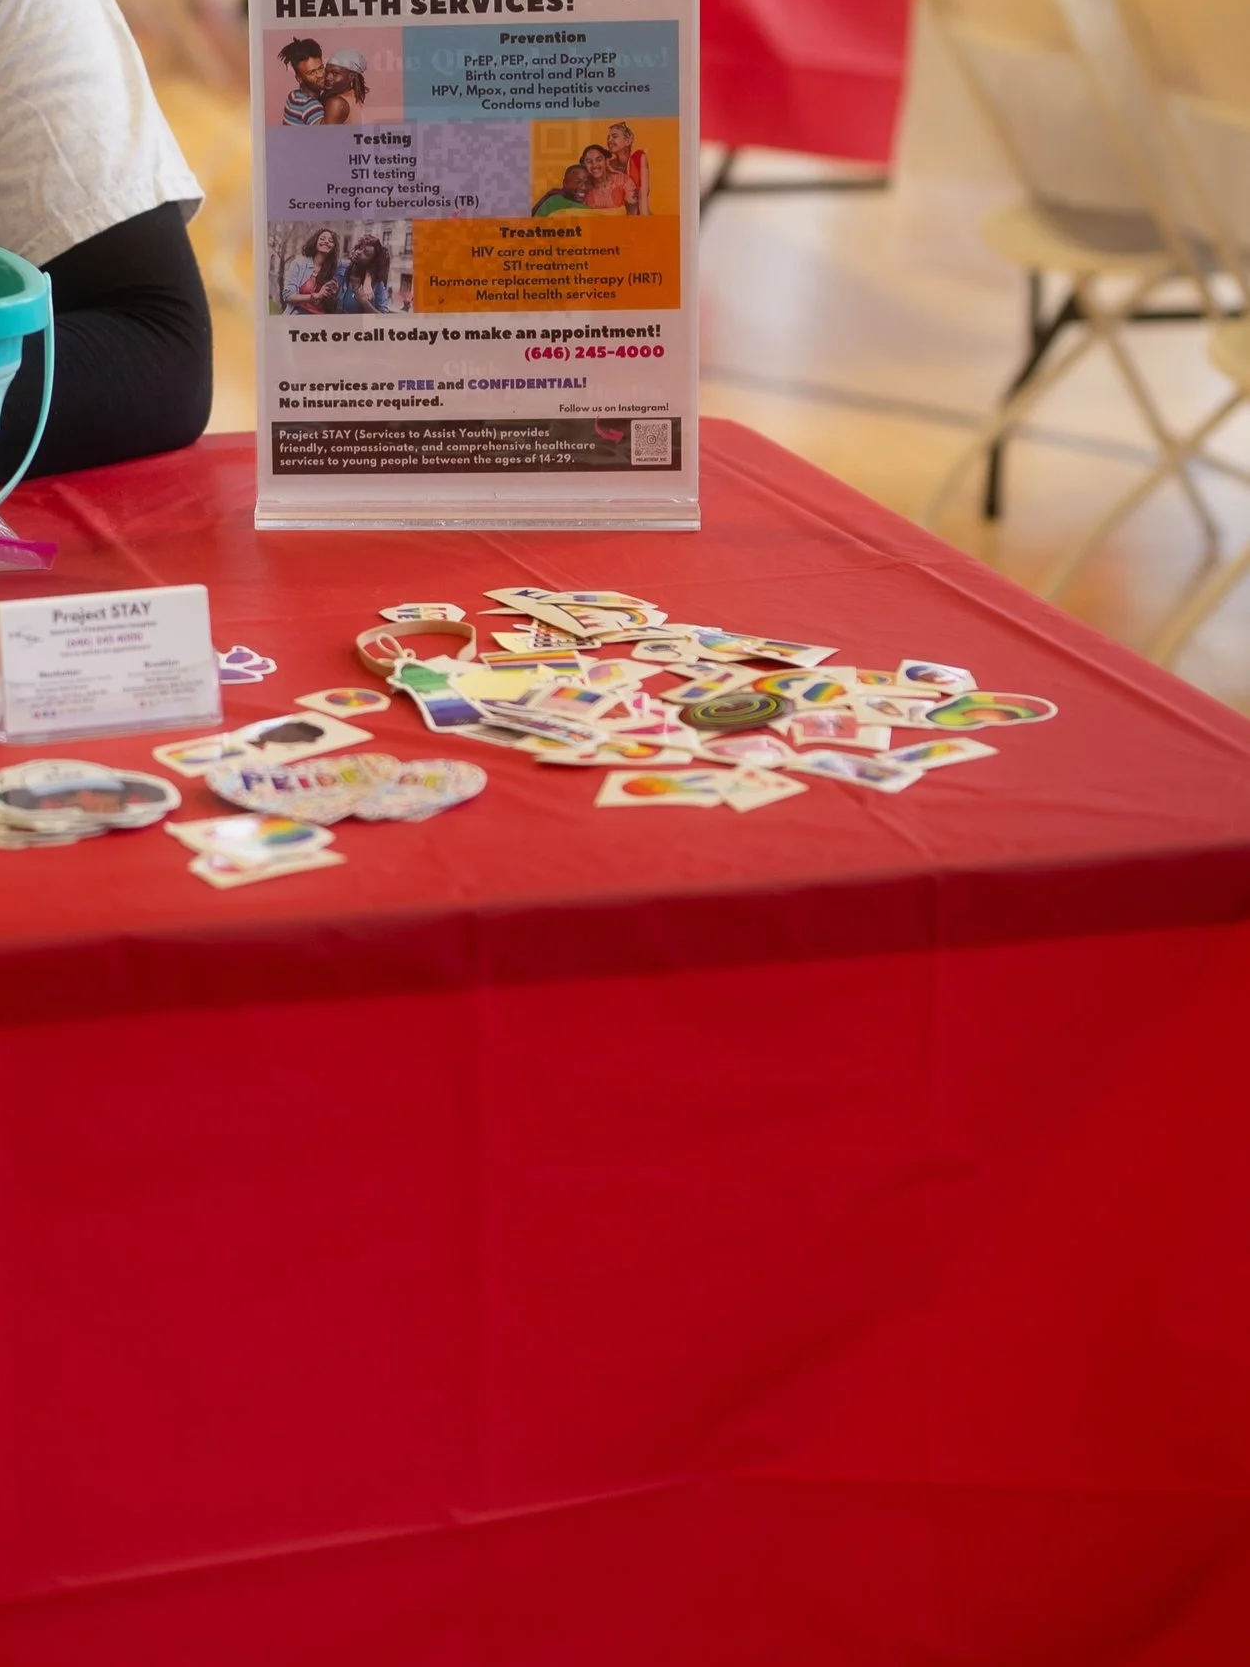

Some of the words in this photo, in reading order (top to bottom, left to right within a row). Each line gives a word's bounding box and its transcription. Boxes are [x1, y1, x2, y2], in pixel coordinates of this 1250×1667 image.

[500, 30, 585, 43] Prevention
[464, 55, 496, 66] PrEP,
[499, 54, 527, 65] PEP,
[532, 54, 556, 64] and
[560, 52, 616, 66] DoxyPEP
[465, 69, 495, 80] Birth
[499, 68, 543, 79] control
[547, 68, 571, 78] and
[576, 68, 603, 78] Plan
[608, 67, 615, 77] B
[432, 85, 463, 96] HPV,
[466, 84, 505, 97] Mpox,
[509, 83, 533, 94] and
[538, 82, 592, 98] hepatitis
[596, 81, 649, 92] vaccines
[481, 98, 540, 109] Condoms
[544, 95, 568, 108] and
[573, 96, 599, 107] lube
[354, 132, 411, 147] Testing
[349, 154, 370, 164] HIV
[374, 153, 416, 167] testing
[351, 168, 368, 178] STI
[373, 165, 415, 181] testing
[327, 183, 393, 196] Pregnancy
[397, 180, 439, 195] testing
[288, 198, 350, 210] Screening
[354, 196, 372, 208] for
[375, 193, 450, 207] tuberculosis
[454, 195, 479, 209] (TB)
[500, 226, 582, 237] Treatment
[471, 246, 493, 256] HIV
[529, 247, 552, 256] and
[556, 246, 619, 255] treatment
[503, 260, 521, 270] STI
[525, 261, 588, 270] treatment
[430, 276, 488, 287] Hormone
[492, 275, 570, 289] replacement
[573, 274, 624, 288] therapy
[627, 273, 662, 285] (HRT)
[475, 289, 519, 300] Mental
[522, 288, 562, 299] health
[565, 288, 616, 298] services
[288, 329, 327, 341] Text
[331, 332, 350, 341] or
[353, 328, 384, 341] call
[388, 327, 438, 345] today
[441, 328, 460, 340] to
[464, 327, 511, 339] make
[515, 329, 536, 338] an
[540, 324, 660, 342] appointment!
[524, 346, 569, 361] (646)
[575, 345, 664, 358] 245-4000
[278, 381, 306, 391] Our
[309, 379, 367, 390] services
[370, 382, 394, 390] are
[398, 380, 434, 390] FREE
[437, 379, 463, 389] and
[467, 377, 586, 389] CONFIDENTIAL!
[279, 398, 299, 407] No
[303, 397, 373, 408] insurance
[376, 395, 443, 409] required.
[559, 404, 589, 412] Follow
[618, 403, 668, 413] Instagram!
[279, 430, 317, 444] Project
[322, 430, 350, 438] STAY
[354, 429, 404, 443] (Services
[423, 428, 455, 442] Assist
[459, 428, 496, 442] Youth)
[500, 428, 549, 442] provides
[279, 443, 327, 455] friendly,
[330, 443, 417, 453] compassionate,
[421, 442, 442, 456] and
[446, 441, 531, 453] comprehensive
[535, 441, 595, 451] healthcare
[280, 457, 324, 466] services
[342, 456, 376, 467] young
[380, 455, 417, 466] people
[422, 455, 469, 464] between
[473, 454, 490, 463] the
[495, 457, 520, 465] ages
[524, 453, 535, 462] of
[539, 453, 574, 462] 14-29.
[52, 607, 106, 625] Project
[111, 601, 151, 618] STAY
